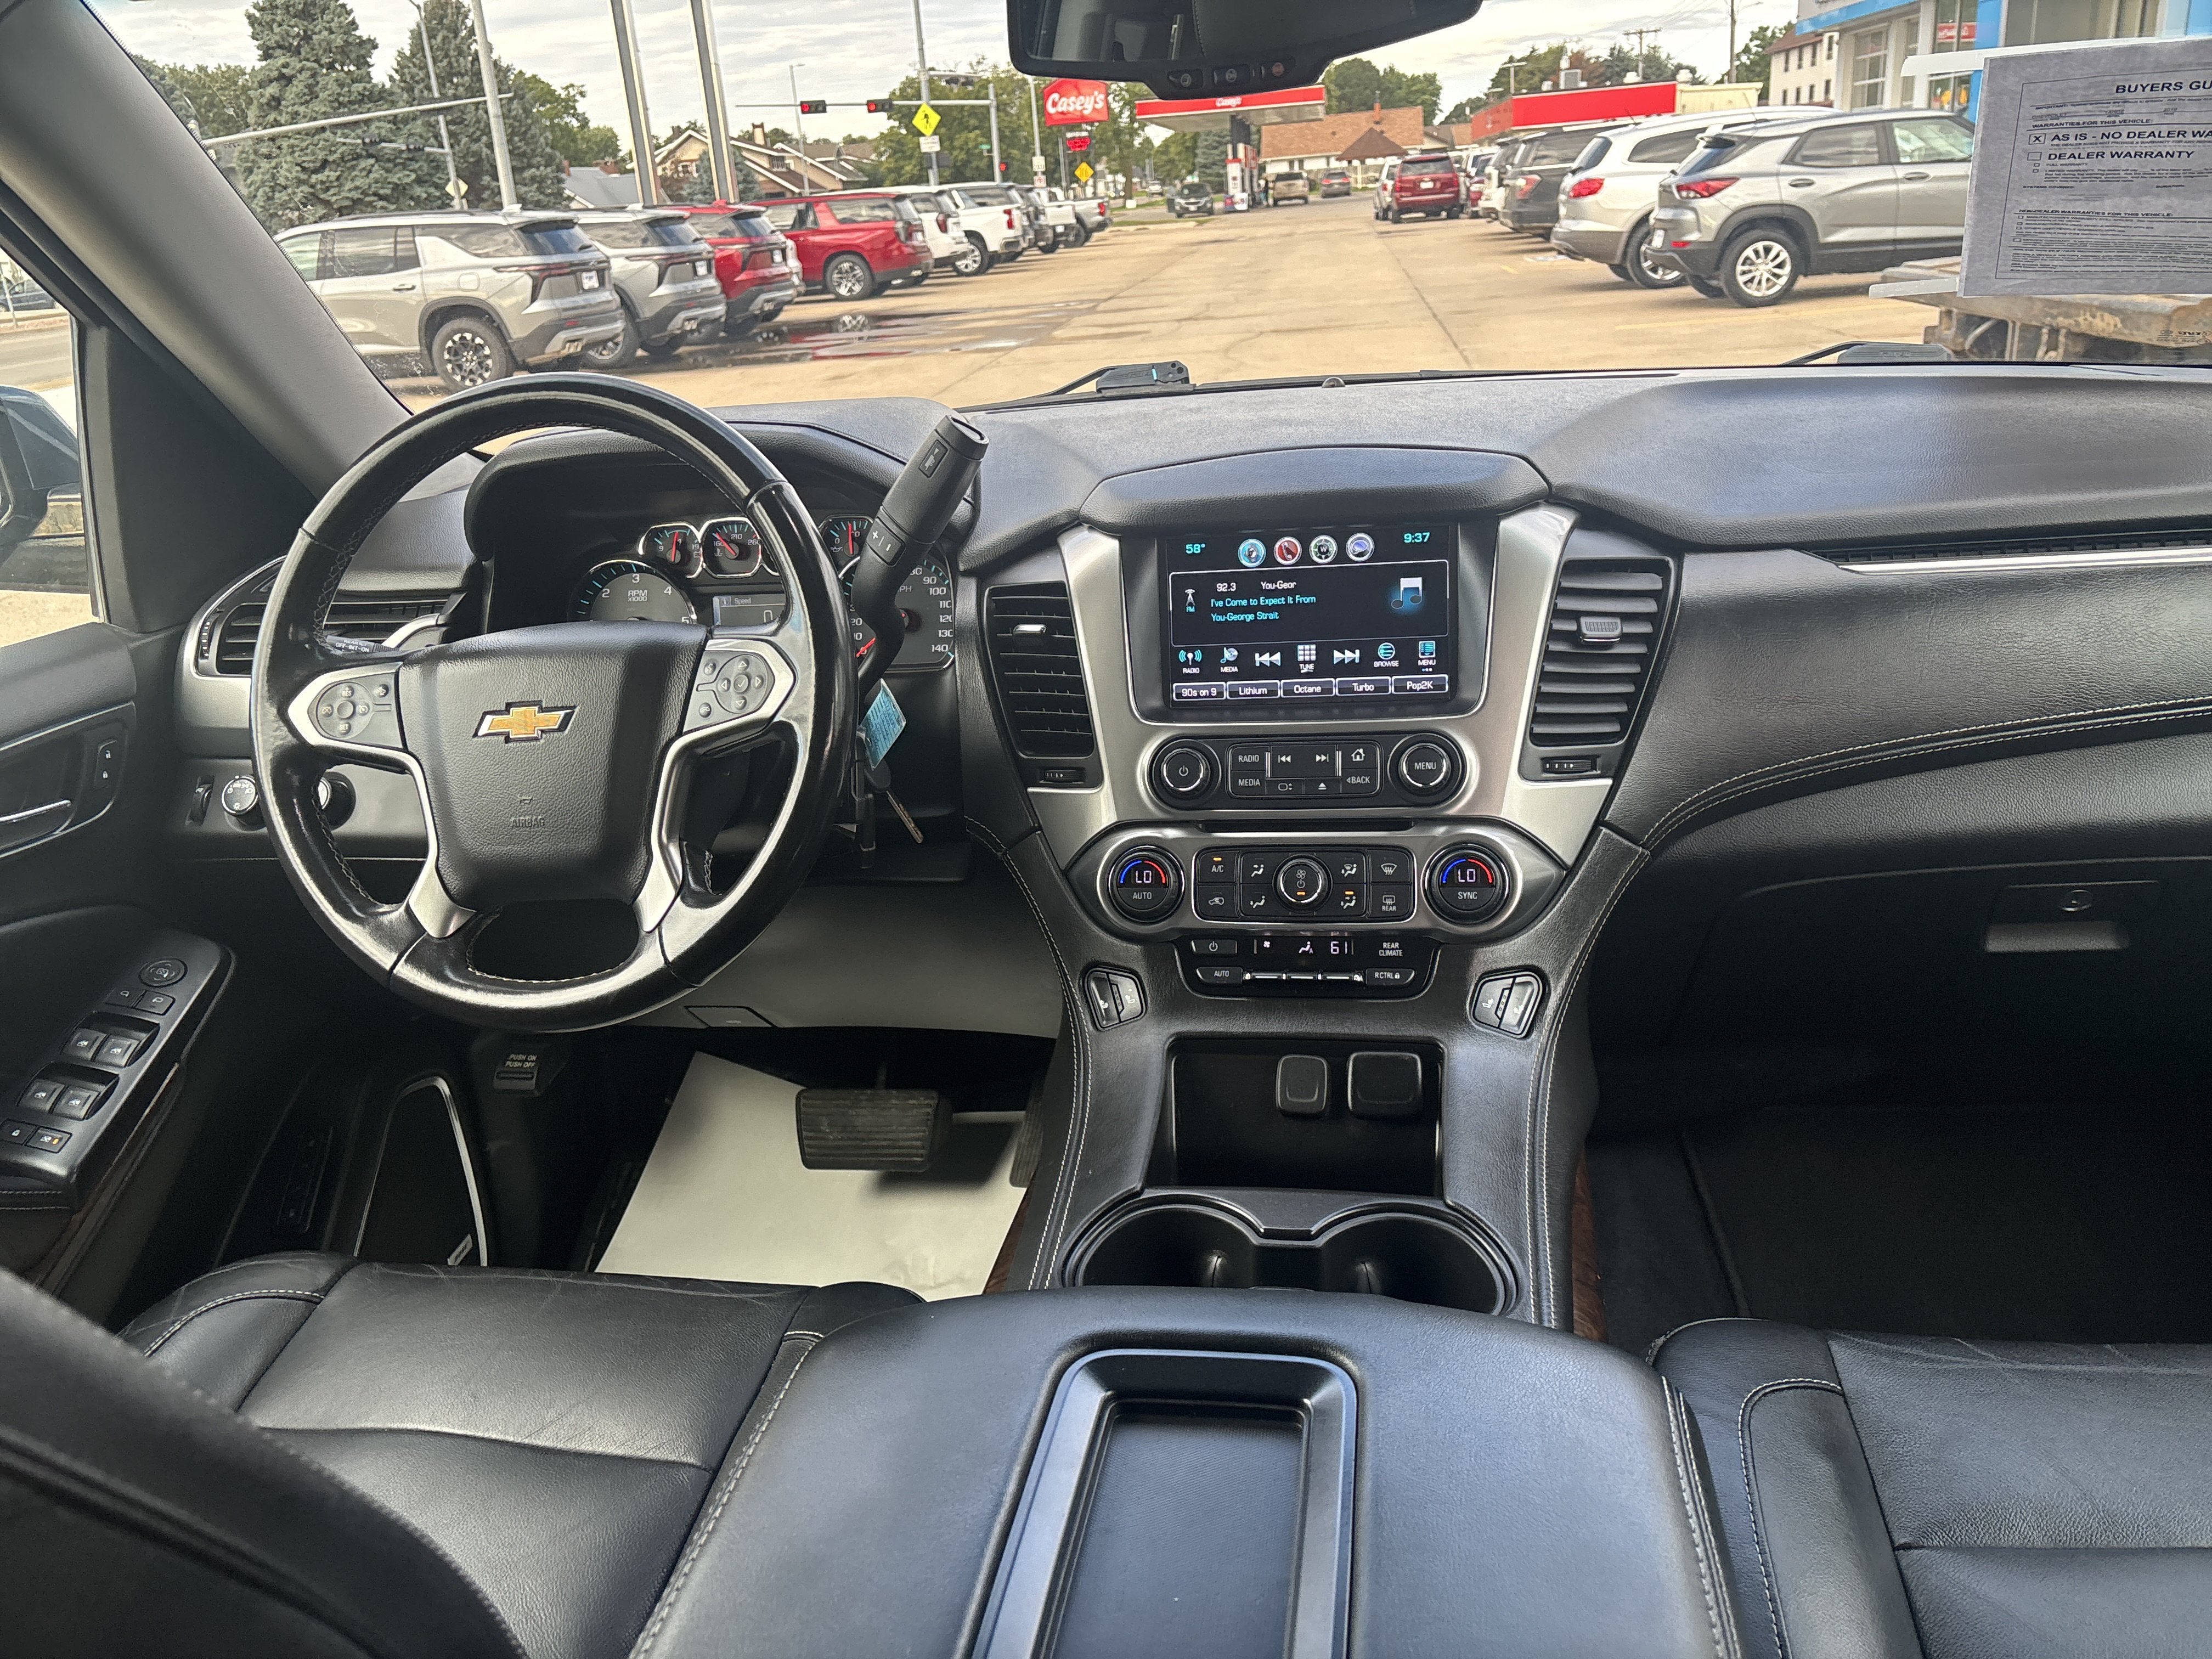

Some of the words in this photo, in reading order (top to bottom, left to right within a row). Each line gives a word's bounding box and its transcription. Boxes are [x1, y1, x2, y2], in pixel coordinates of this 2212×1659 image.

[2115, 82, 2183, 93] BUYERS
[1046, 91, 1105, 115] Casey's
[2049, 151, 2105, 160] DEALER
[1186, 543, 1206, 554] 58°
[1403, 532, 1431, 544] 9:37
[602, 589, 610, 597] 2
[632, 574, 640, 583] 3
[664, 586, 672, 595] 4
[1216, 582, 1237, 592] 92.3
[1260, 580, 1296, 590] You-Geor
[929, 587, 946, 595] 100
[1211, 598, 1223, 608] I've
[1226, 597, 1247, 606] Come
[1250, 597, 1258, 606] to
[1260, 596, 1285, 606] Expect
[1288, 595, 1293, 604] It
[1295, 595, 1316, 604] From
[764, 611, 772, 622] 0
[1211, 612, 1255, 623] You-George
[1256, 611, 1279, 620] Strait
[1294, 684, 1321, 693] Octane
[1352, 682, 1374, 692] Turbo
[1407, 680, 1433, 690] Pop2K
[1181, 687, 1197, 697] 90s
[1210, 687, 1217, 696] 9
[1239, 685, 1267, 696] Lithium
[1238, 754, 1260, 763] RADIO
[1414, 761, 1437, 770] MENU
[1238, 778, 1261, 787] MEDIA
[1351, 776, 1370, 785] BACK
[512, 817, 545, 827] AIRBAG
[1211, 864, 1224, 873] A/C
[1135, 870, 1152, 883] LO
[1457, 868, 1476, 882] LO
[1132, 891, 1153, 900] AUTO
[1457, 891, 1478, 900] SYNC
